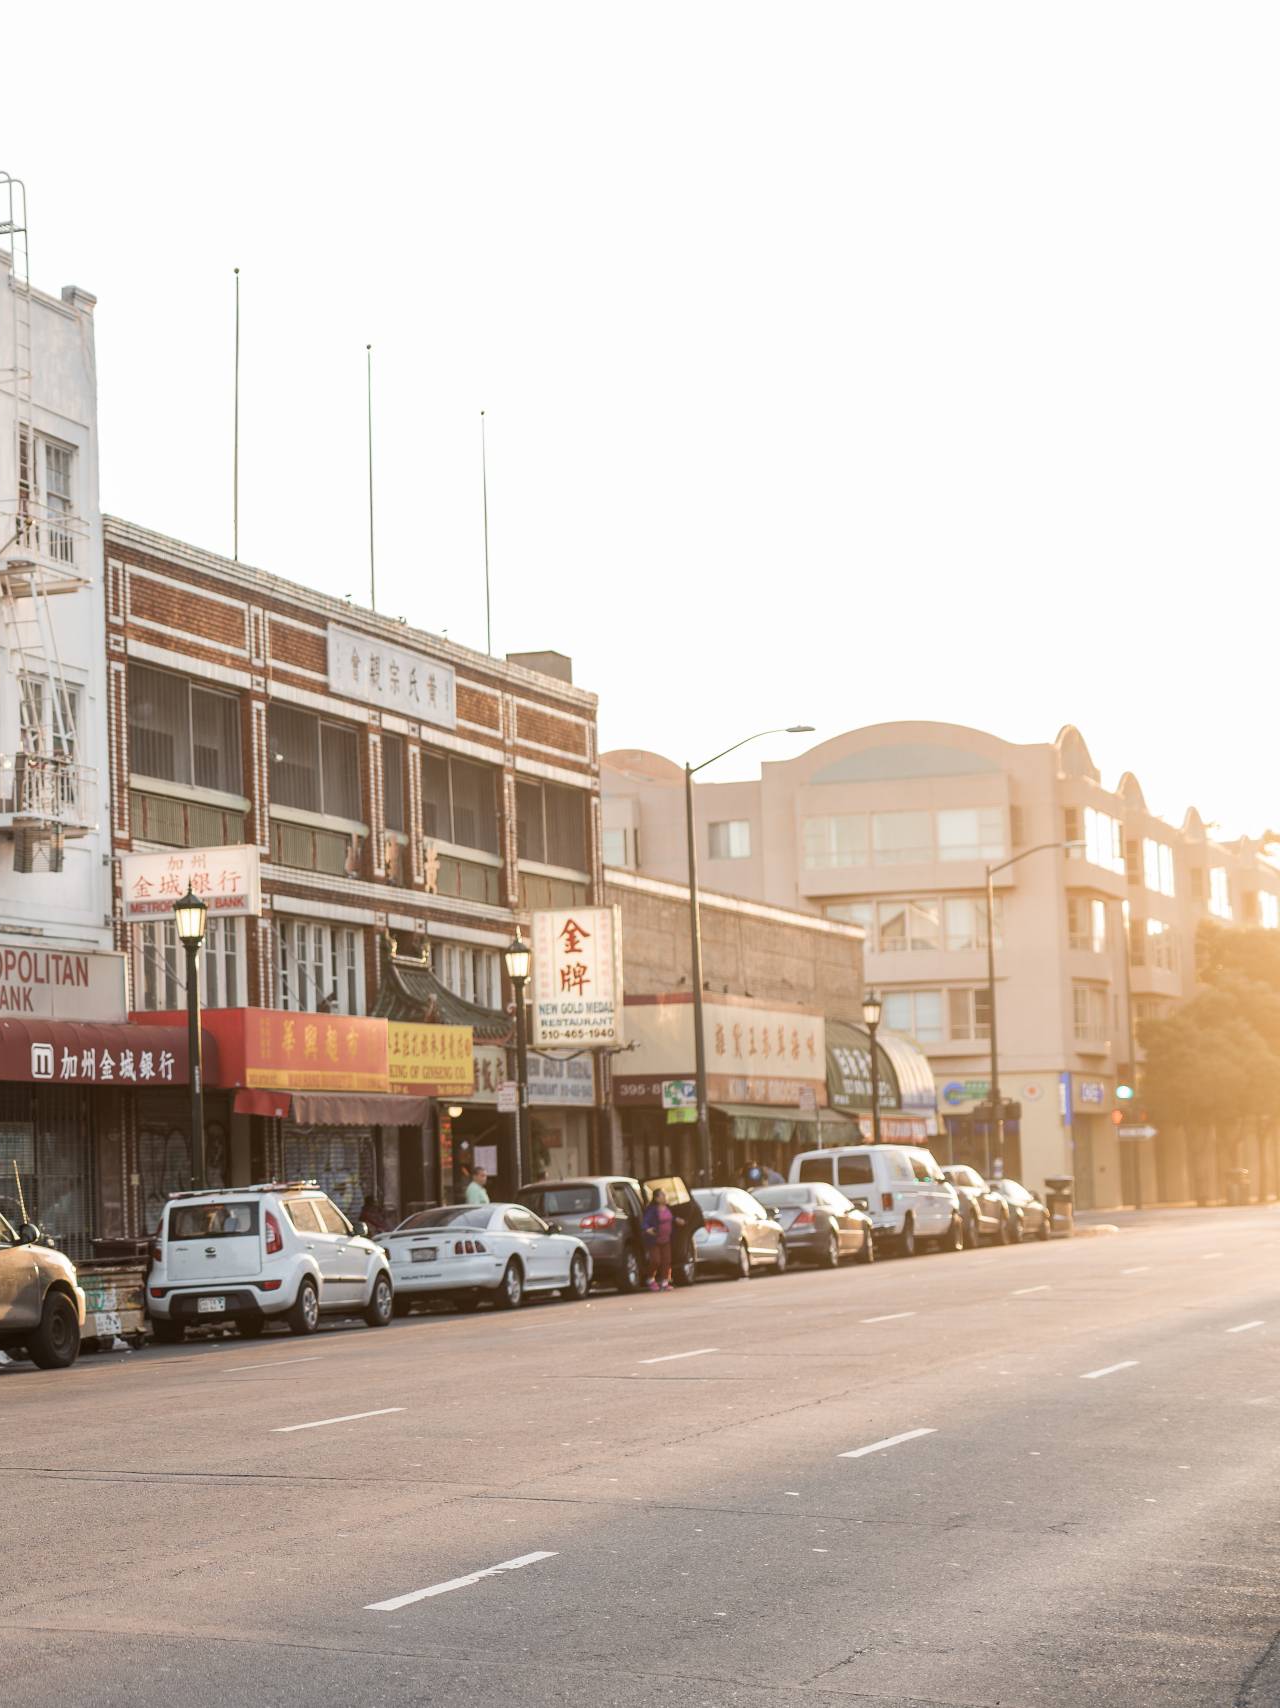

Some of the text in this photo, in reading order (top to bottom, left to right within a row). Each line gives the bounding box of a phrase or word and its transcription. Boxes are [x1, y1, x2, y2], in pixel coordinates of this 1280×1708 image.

[215, 897, 245, 909] BANK
[559, 917, 591, 997] 金牌
[538, 1001, 615, 1016] NEW GOLD MEDAL
[541, 1017, 614, 1028] RESTAURANT
[59, 1046, 176, 1082] 加州金城銀行
